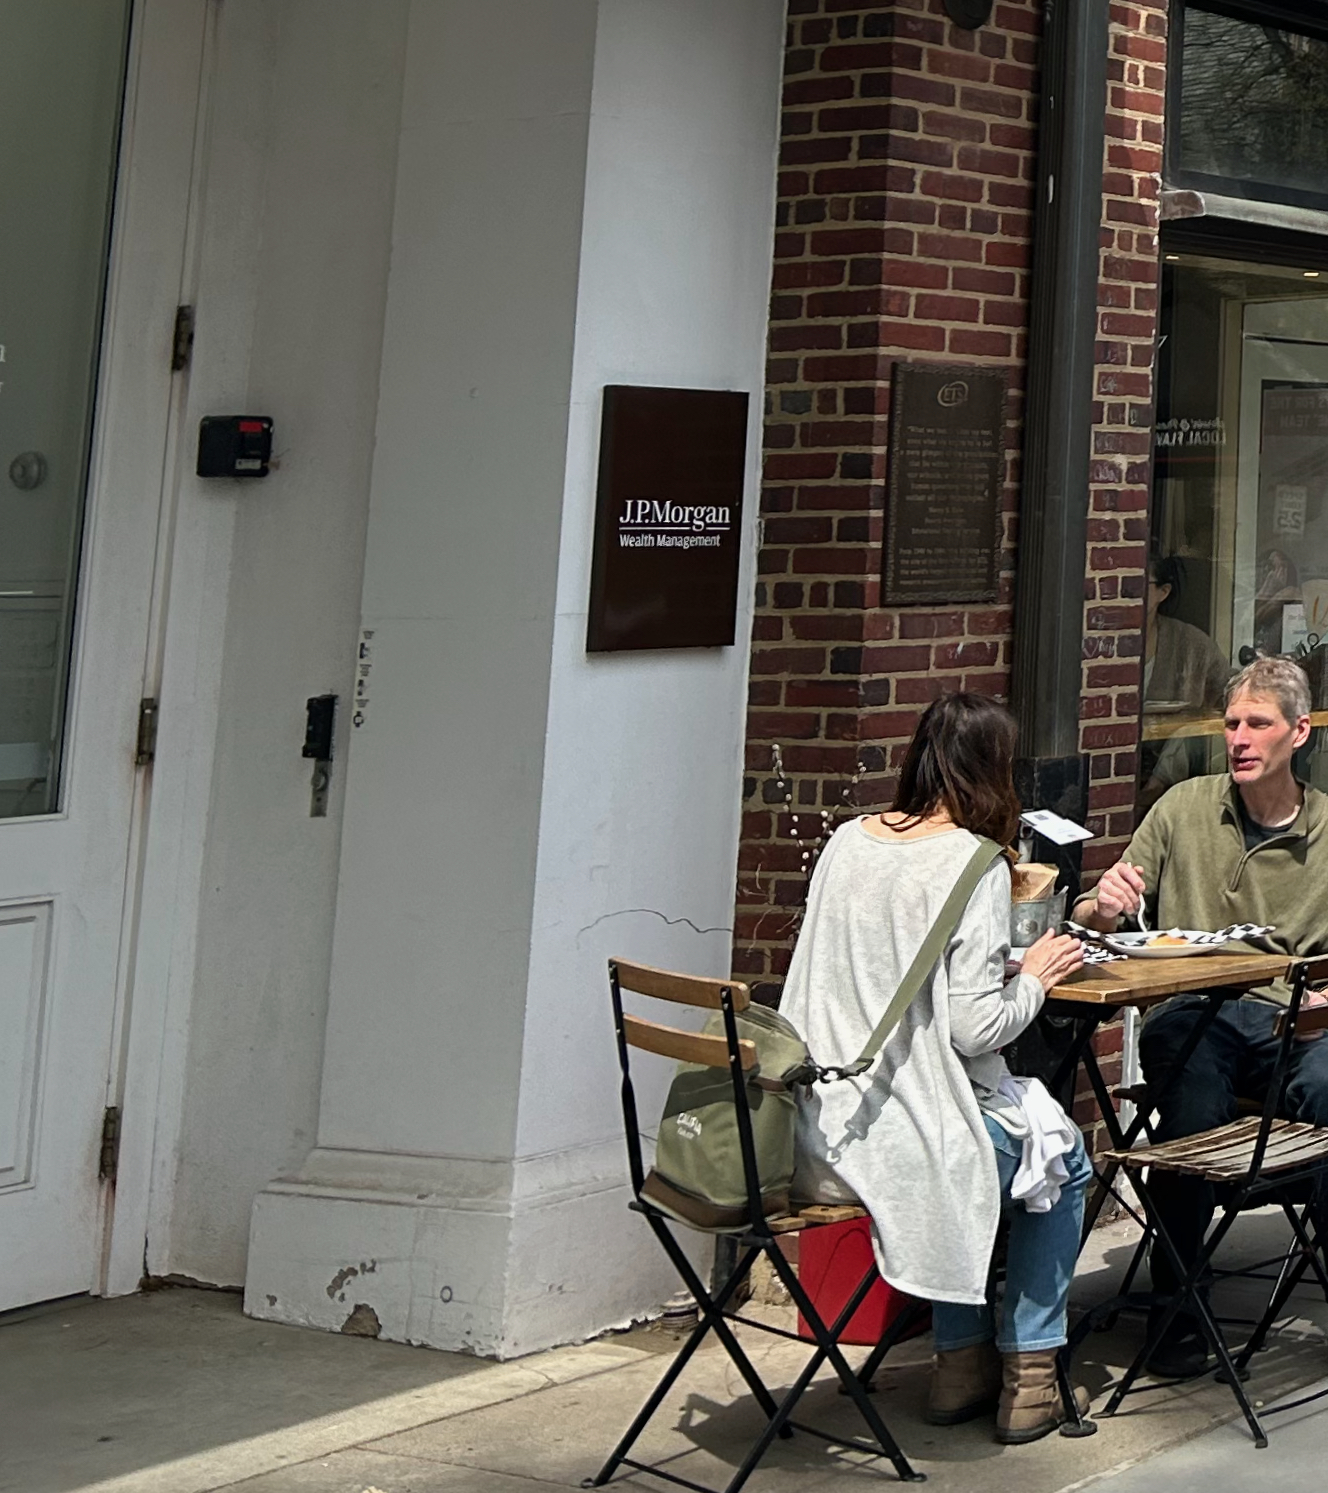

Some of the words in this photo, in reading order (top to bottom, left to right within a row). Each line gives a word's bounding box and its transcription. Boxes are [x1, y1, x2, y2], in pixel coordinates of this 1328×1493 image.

[619, 499, 730, 532] J.P.Morgan
[619, 533, 655, 547] Wealth
[656, 534, 721, 549] Management
